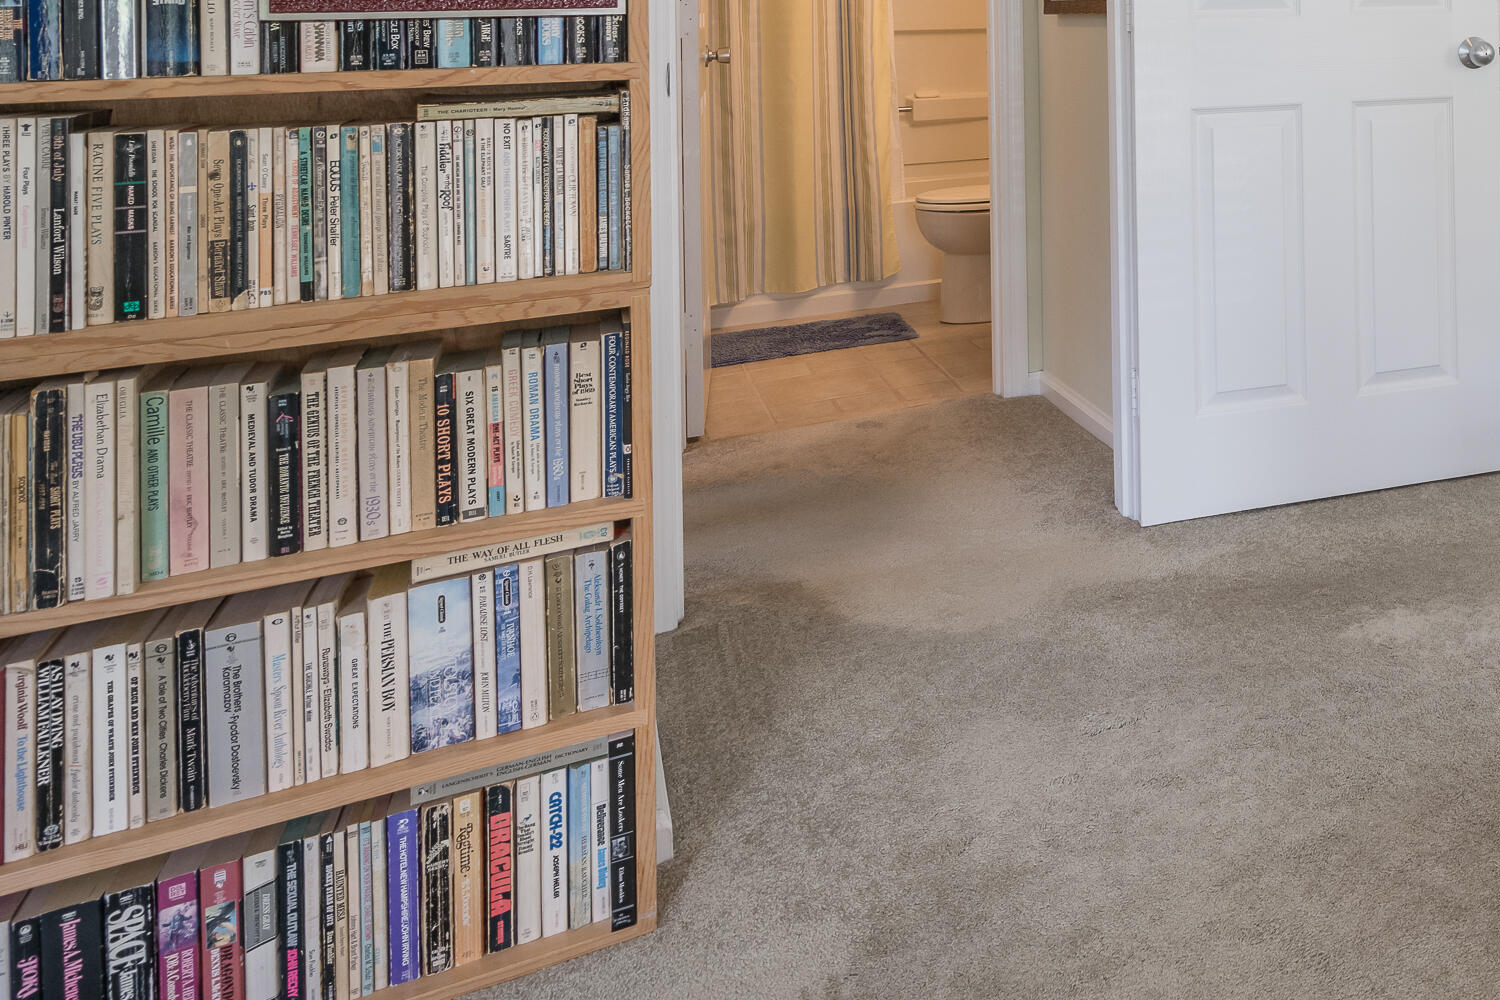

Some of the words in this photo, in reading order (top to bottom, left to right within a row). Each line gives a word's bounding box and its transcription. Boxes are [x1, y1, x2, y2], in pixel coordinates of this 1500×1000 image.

[242, 21, 258, 49] Cabin
[91, 142, 104, 183] RACINE
[438, 141, 453, 173] Fiddler
[328, 159, 341, 193] EQUUS
[91, 186, 103, 212] FIVE
[328, 195, 340, 216] Peter
[440, 188, 453, 210] Roof
[91, 215, 103, 245] PLAYS
[328, 217, 340, 247] Shaffer
[437, 403, 450, 416] 10
[466, 390, 476, 406] SIX
[96, 392, 109, 446] Elizabethan
[146, 396, 165, 445] Camille
[248, 413, 257, 450] MEDIEVAL
[466, 407, 476, 436] GREAT
[437, 419, 451, 461] SHORT
[96, 446, 109, 479] Drama
[147, 448, 159, 464] AND
[249, 450, 257, 467] AND
[466, 437, 477, 476] MODERN
[147, 465, 159, 488] OTHER
[249, 468, 258, 493] TUDOR
[438, 463, 452, 504] PLAYS
[467, 477, 477, 506] PLAYS
[147, 489, 158, 512] PLAYS
[249, 495, 258, 523] DRAMA
[446, 552, 470, 565] THE
[471, 548, 495, 561] WAY
[496, 545, 512, 556] OF
[512, 541, 532, 552] ALL
[533, 534, 564, 551] FLESH
[382, 622, 395, 638] THE
[231, 664, 242, 680] The
[380, 638, 396, 687] PERSIAN
[37, 665, 50, 719] WILLIAM
[221, 666, 233, 713] Karamazov
[231, 680, 242, 713] Brothers
[381, 689, 396, 712] BOY
[229, 715, 242, 744] Fyodor
[37, 719, 50, 787] FAULKNER
[229, 744, 242, 791] Dostoevsky
[549, 791, 563, 851] CATCH-22
[456, 822, 474, 874] Ragtime
[287, 862, 297, 879] THE
[490, 811, 512, 918] DRACULA
[287, 879, 298, 911] SEXUAL
[108, 904, 147, 973] SPACE
[287, 912, 298, 947] OUTLAW
[287, 948, 298, 969] JOHN
[287, 969, 299, 998] RECHY
